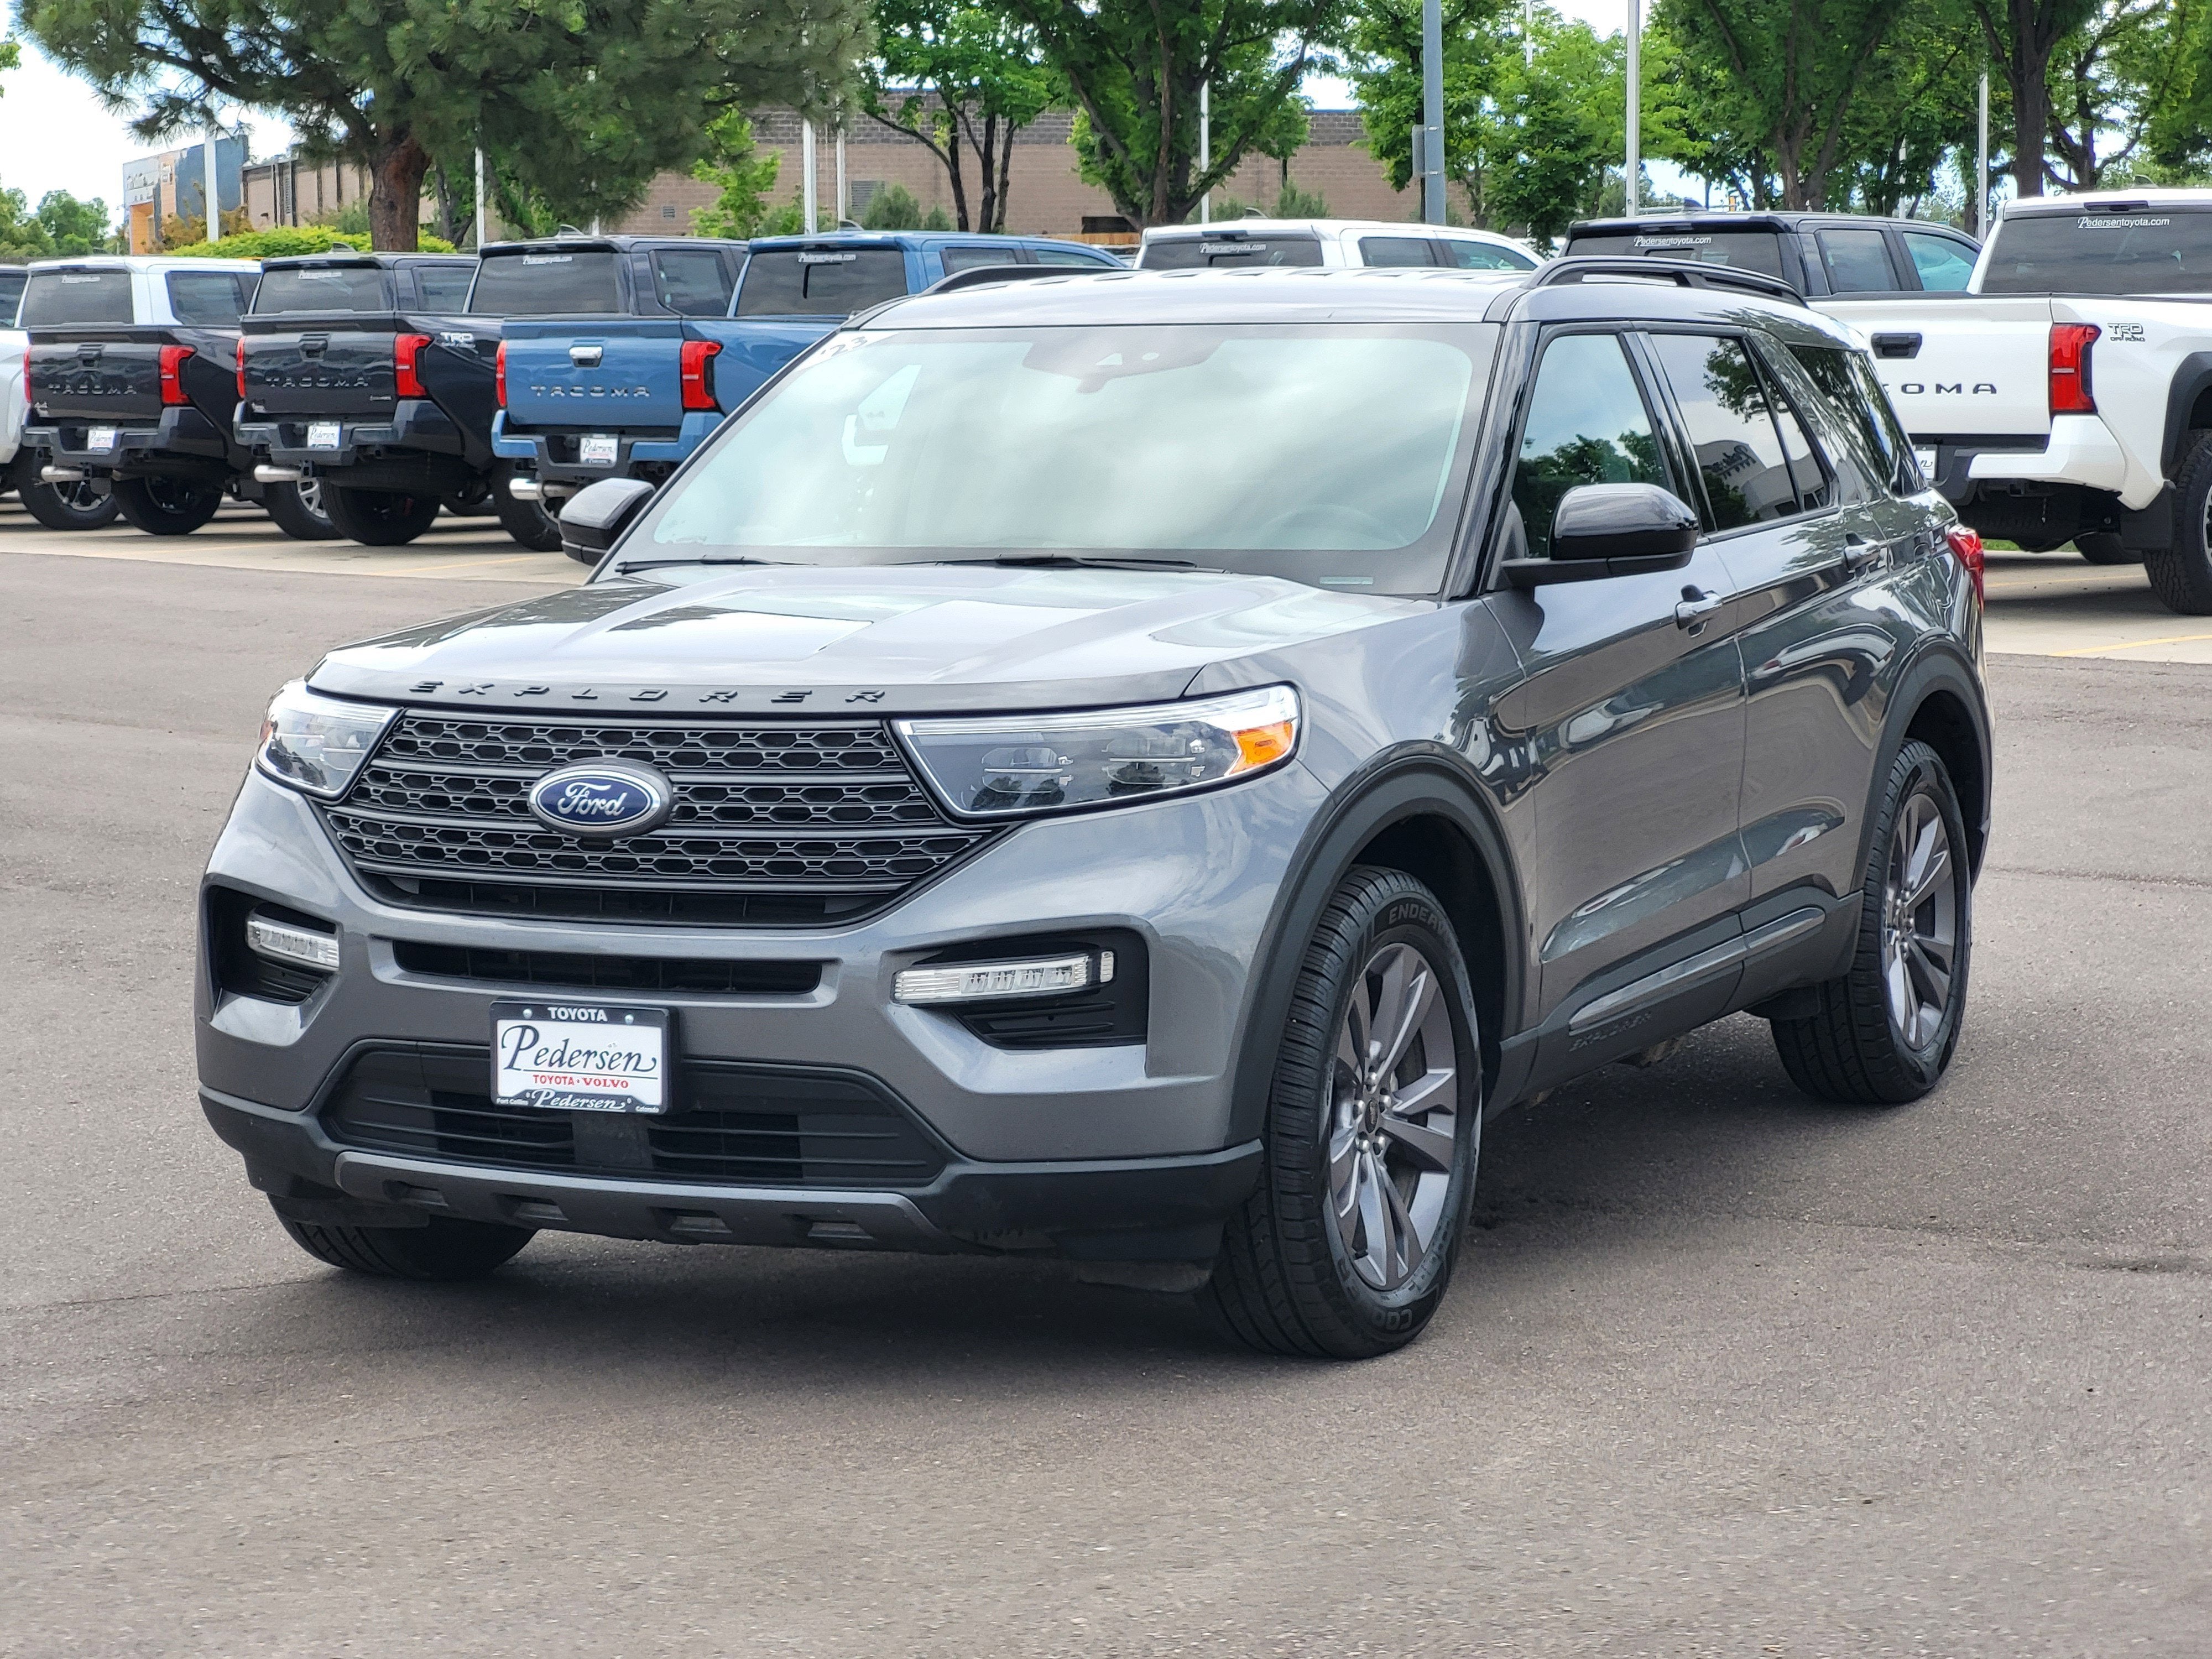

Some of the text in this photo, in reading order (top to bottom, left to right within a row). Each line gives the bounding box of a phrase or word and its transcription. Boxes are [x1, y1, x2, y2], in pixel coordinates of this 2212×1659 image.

[2078, 217, 2169, 228] Pedersentoyota.com
[1634, 236, 1712, 247] Pedersentoyota.com
[440, 332, 474, 342] TRD
[2107, 323, 2143, 338] TRD
[265, 377, 369, 387] TACOMA
[1881, 383, 1997, 394] OMA
[48, 384, 137, 395] TACOMA
[530, 385, 650, 397] TACOMA
[409, 681, 885, 703] EXPLORER
[557, 782, 628, 816] Ford
[547, 1006, 608, 1022] TOYOTA
[501, 1025, 657, 1072] Pedersen
[533, 1074, 629, 1089] TOYOTA VOLVO
[531, 1088, 625, 1110] Pedersen
